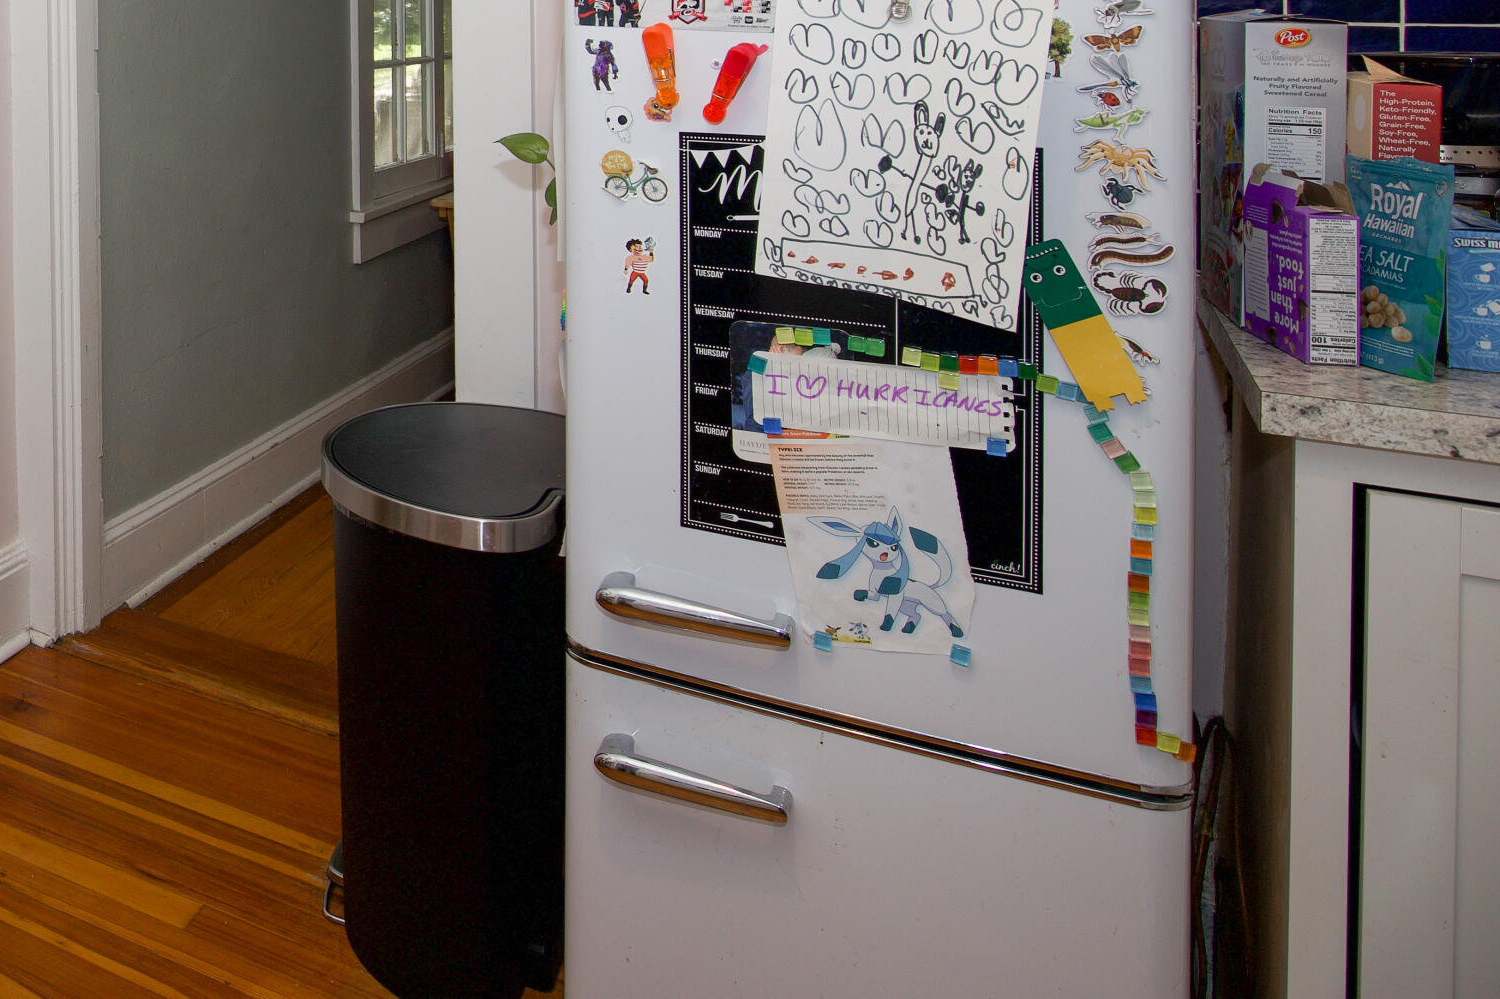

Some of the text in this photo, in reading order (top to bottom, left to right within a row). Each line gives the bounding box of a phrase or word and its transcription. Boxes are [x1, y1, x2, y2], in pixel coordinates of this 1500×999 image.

[1279, 31, 1306, 43] Post
[1302, 77, 1338, 85] Artificially
[1379, 89, 1396, 97] The
[1379, 98, 1435, 107] High-Protein,
[1379, 106, 1437, 115] Keto-Friendly,
[1379, 113, 1431, 123] Gluten-Free,
[1379, 121, 1426, 130] Grain-Free,
[1379, 129, 1418, 138] Soy-Free,
[1378, 137, 1431, 146] Wheat-Free,
[1378, 145, 1416, 153] Naturally
[1370, 183, 1423, 219] Royal
[1363, 213, 1415, 238] Hawaiian
[694, 229, 722, 238] MONDAY
[1360, 245, 1415, 273] EA SALT
[695, 268, 724, 279] TUESDAY
[1275, 254, 1304, 281] food.
[1361, 264, 1404, 282] CADAMIAS
[1277, 274, 1297, 298] just
[1270, 290, 1293, 312] than
[695, 307, 735, 319] WEDNESDAY
[1274, 311, 1299, 336] More
[695, 347, 729, 359] THURSDAY
[765, 373, 789, 396] I
[695, 386, 718, 397] FRIDAY
[695, 425, 729, 437] SATURDAY
[695, 464, 721, 476] SUNDAY
[990, 561, 1020, 574] cinch!
